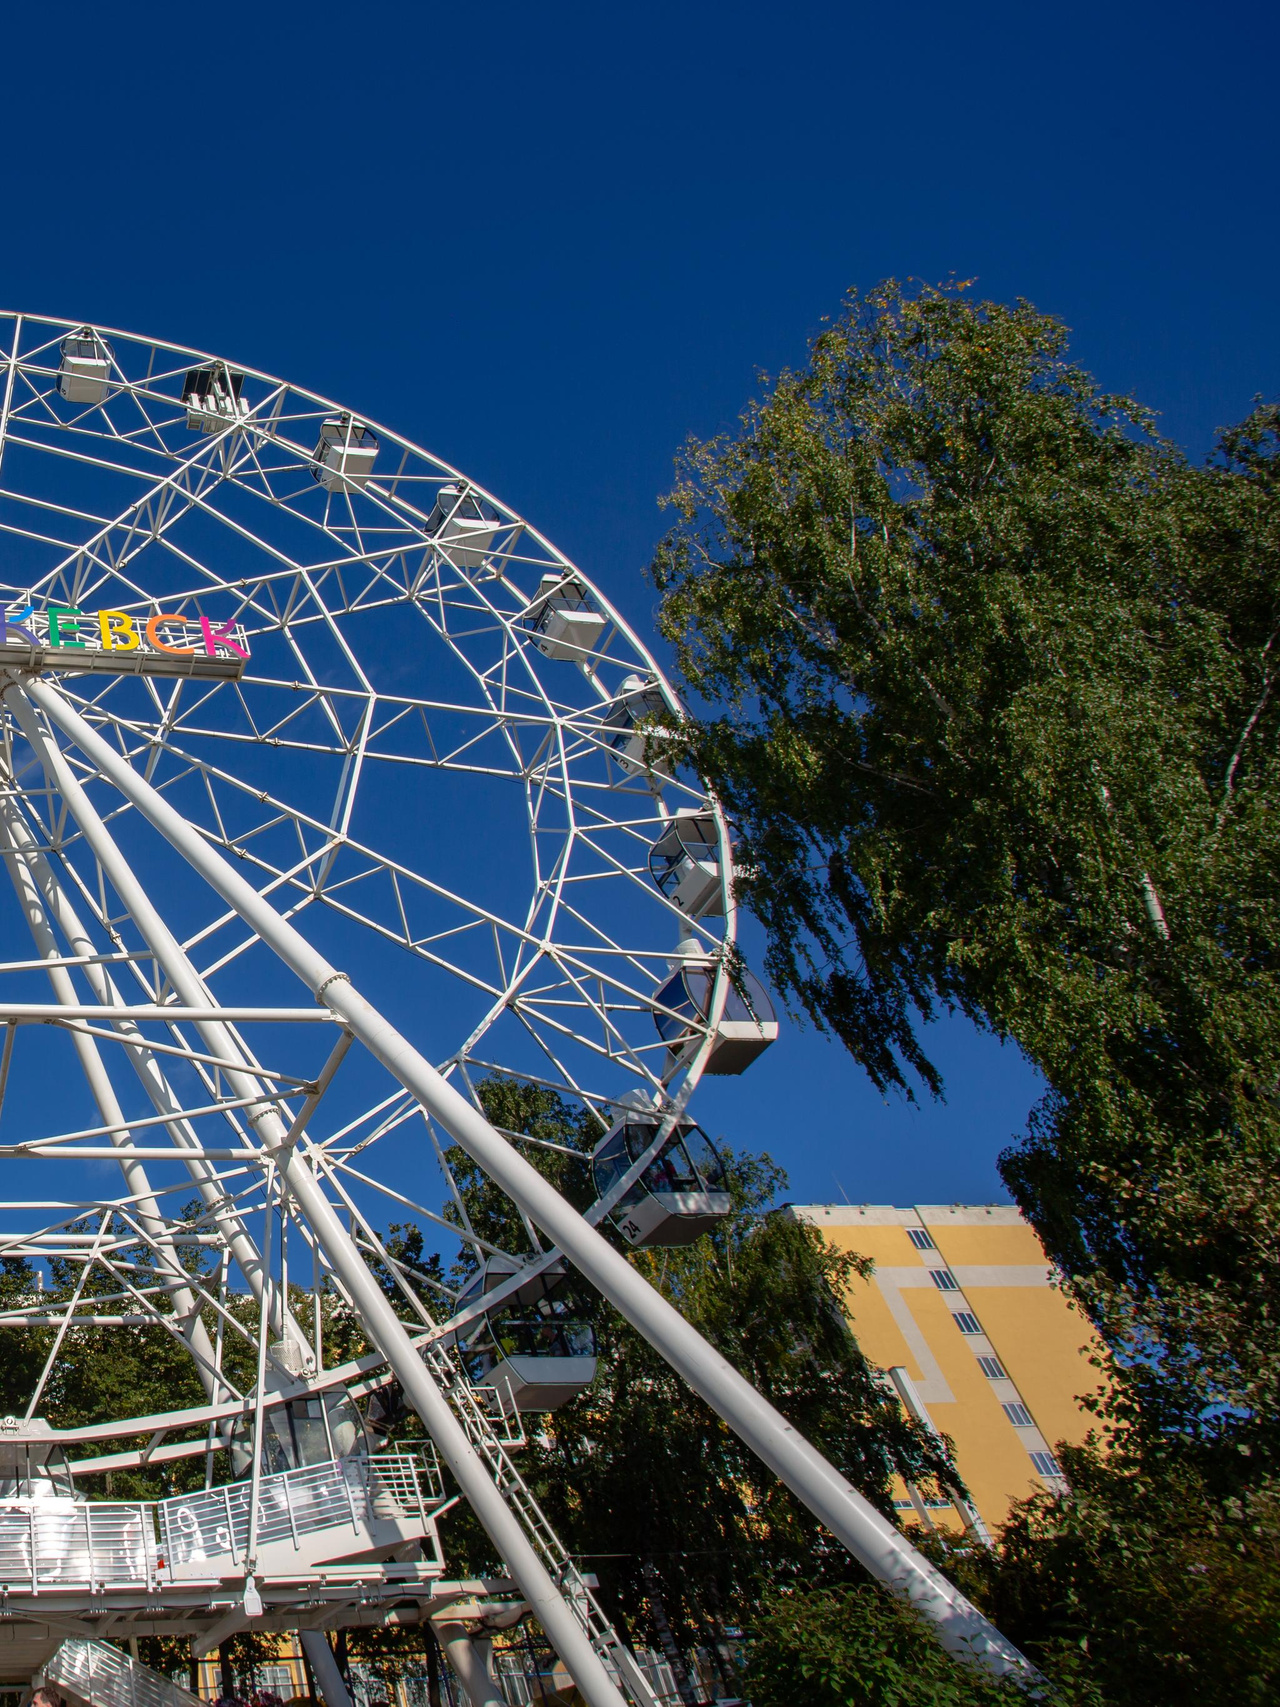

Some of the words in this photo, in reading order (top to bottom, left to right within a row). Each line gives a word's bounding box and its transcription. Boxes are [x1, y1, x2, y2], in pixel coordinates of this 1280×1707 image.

[540, 643, 549, 652] 4
[620, 759, 629, 769] 3
[673, 896, 684, 907] 2
[622, 1220, 641, 1239] 24
